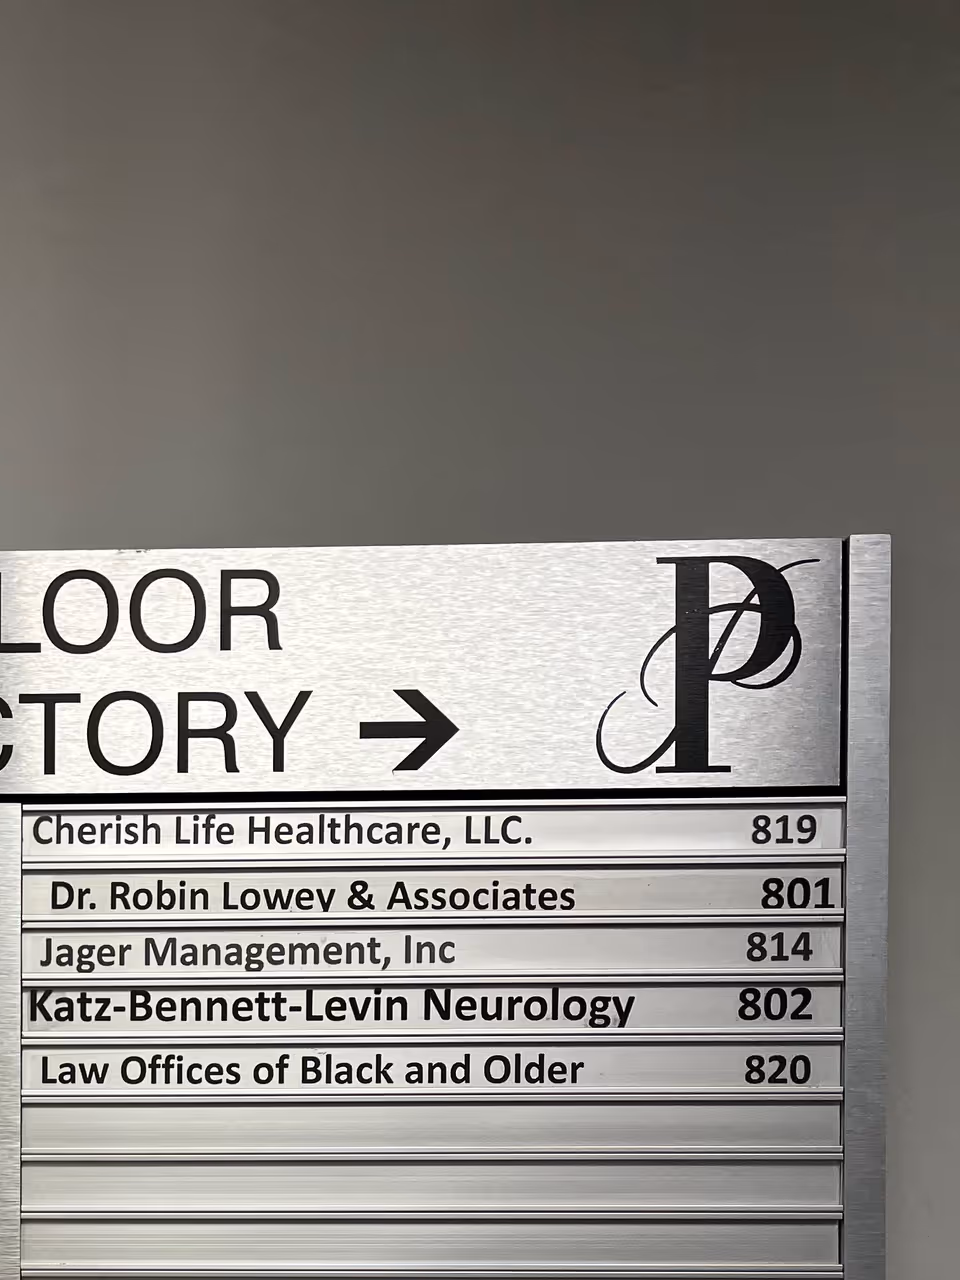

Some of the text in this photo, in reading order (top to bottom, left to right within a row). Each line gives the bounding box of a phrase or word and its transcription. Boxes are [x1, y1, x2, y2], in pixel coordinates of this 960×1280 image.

[32, 814, 816, 849] Cherish Life Healthcare, LLC. 819
[52, 882, 95, 909] Dr.
[111, 880, 208, 910] Robin
[348, 881, 375, 910] &
[387, 881, 575, 910] Associates
[761, 878, 835, 909] 801
[40, 932, 813, 973] Jager Management, Inc 814
[28, 987, 813, 1028] Katz-Bennett-Levin Neurology 802
[42, 1054, 811, 1084] Law Offices of Black and Older 820
